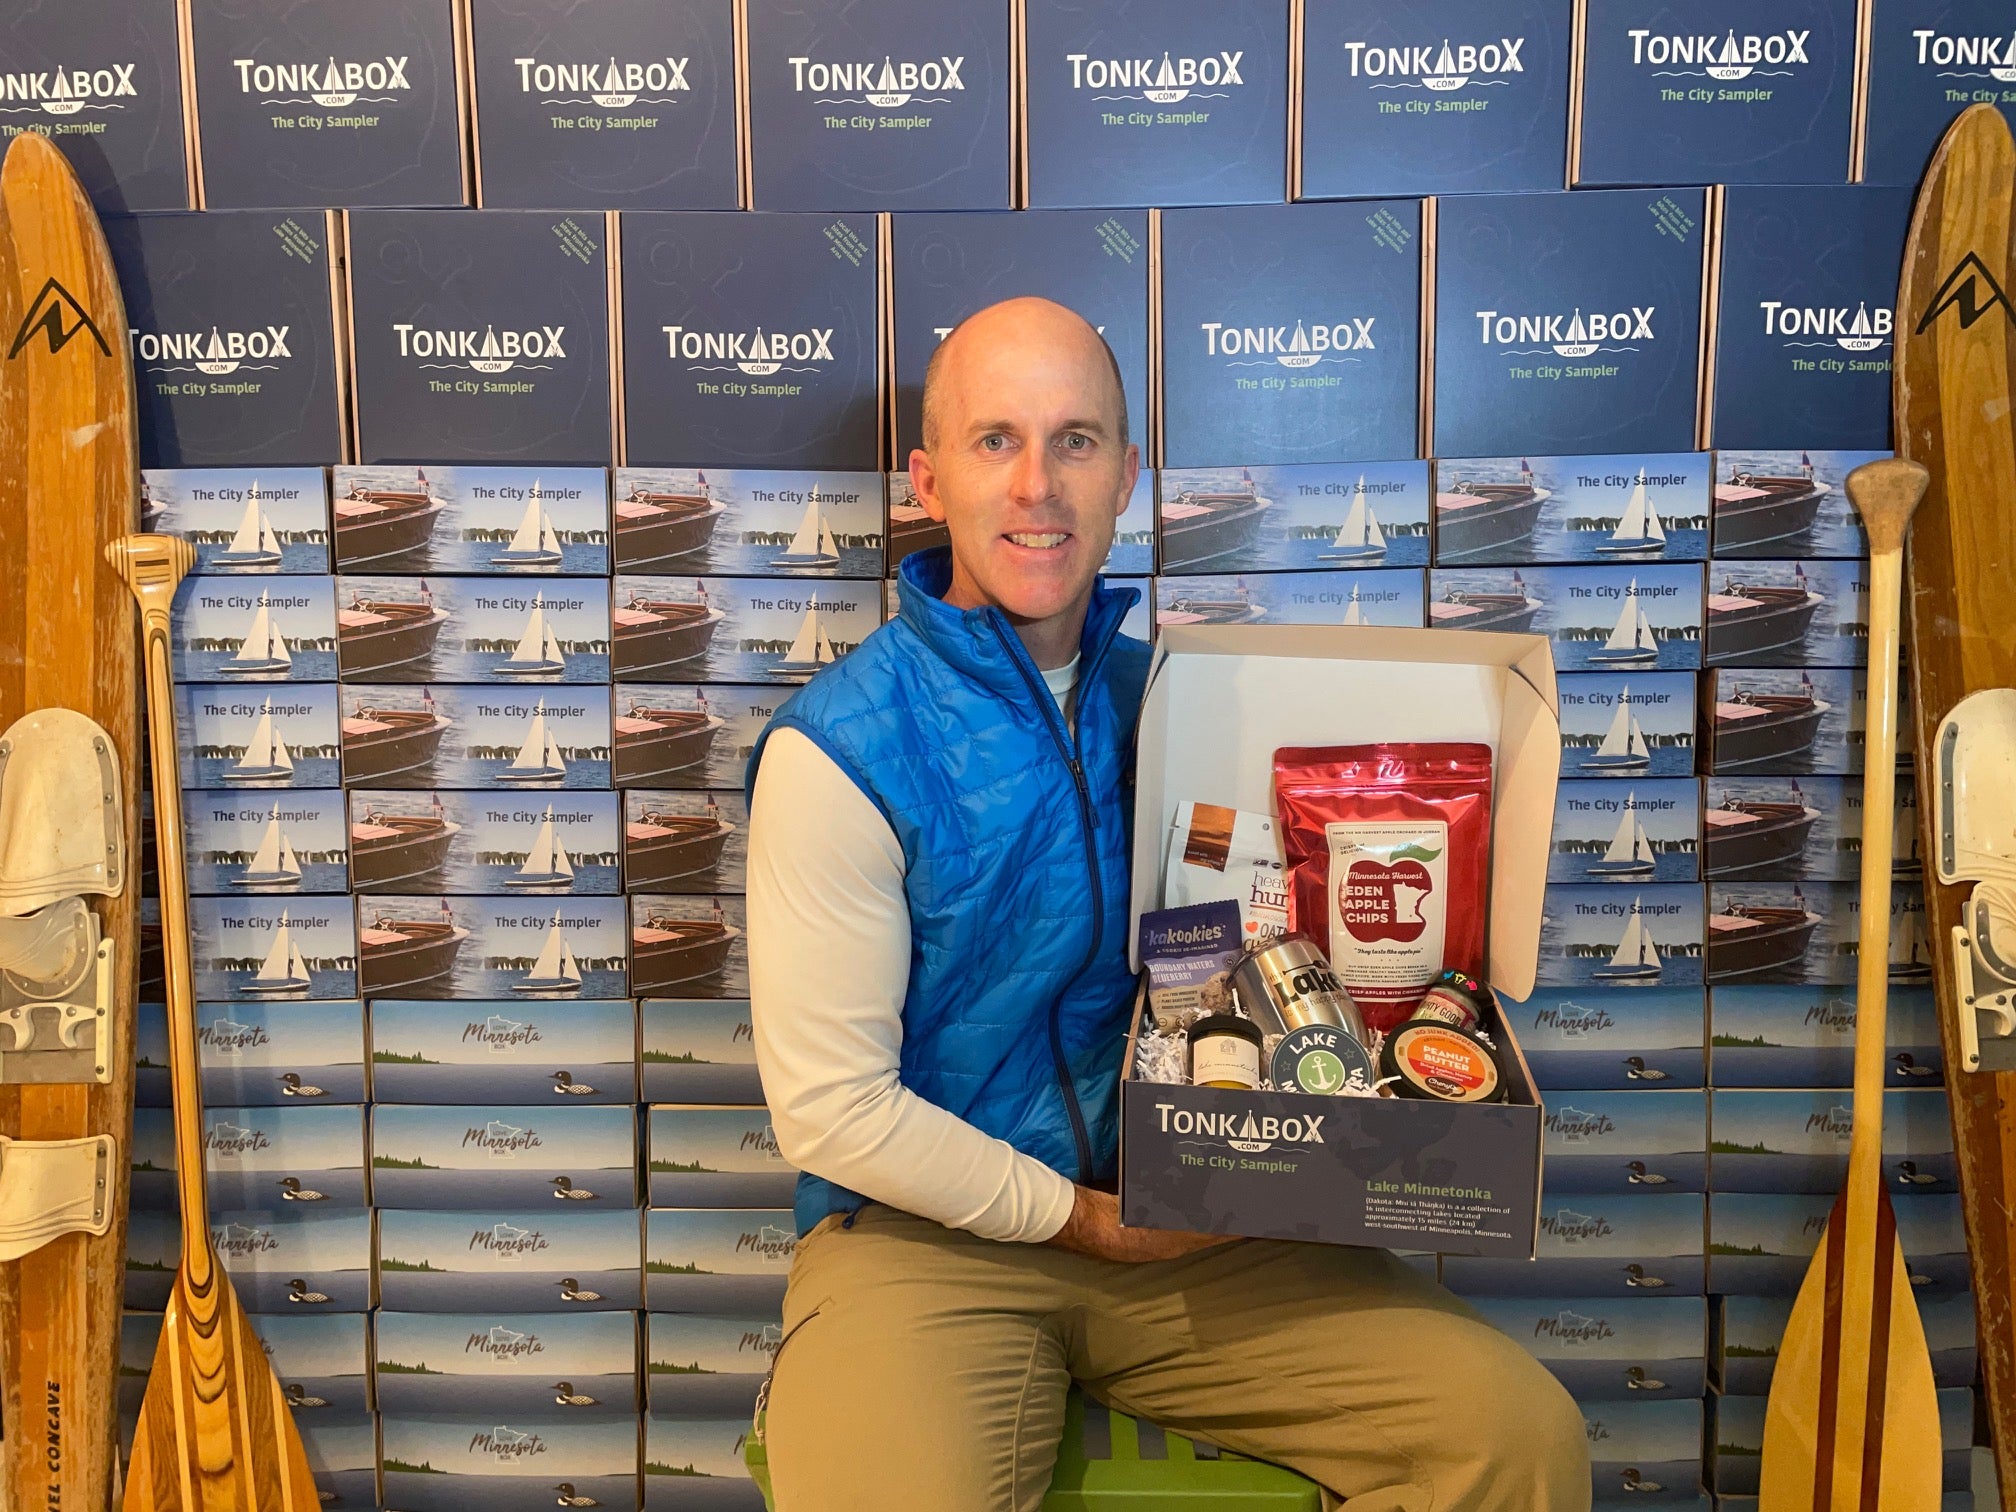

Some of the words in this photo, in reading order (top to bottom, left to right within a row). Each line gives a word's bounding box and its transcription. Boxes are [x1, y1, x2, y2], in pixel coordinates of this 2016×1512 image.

[1661, 88, 1684, 101] The
[1689, 88, 1714, 103] City
[1718, 87, 1773, 102] Sampler
[1378, 101, 1401, 113] The
[1406, 100, 1431, 115] City
[1435, 99, 1488, 113] Sampler
[271, 116, 294, 128] The
[298, 115, 323, 130] City
[327, 114, 379, 129] Sampler
[824, 116, 847, 128] The
[851, 116, 875, 131] City
[879, 115, 932, 130] Sampler
[1101, 113, 1124, 125] The
[1128, 112, 1153, 127] City
[1157, 111, 1210, 126] Sampler
[1509, 367, 1532, 379] The
[1537, 366, 1561, 380] City
[1566, 365, 1619, 379] Sampler
[1792, 359, 1815, 370] The
[1819, 358, 1844, 373] City
[157, 384, 178, 394] The
[183, 383, 206, 396] City
[210, 382, 261, 396] Sampler
[429, 380, 451, 392] The
[455, 380, 479, 395] City
[483, 381, 535, 395] Sampler
[697, 382, 719, 394] The
[723, 382, 747, 397] City
[751, 383, 802, 397] Sampler
[1236, 378, 1258, 389] The
[1262, 377, 1286, 391] City
[1290, 375, 1342, 389] Sampler
[1577, 476, 1600, 487] The
[1605, 475, 1629, 489] City
[1634, 474, 1687, 488] Sampler
[192, 489, 214, 500] The
[219, 489, 243, 502] City
[247, 488, 299, 501] Sampler
[1298, 485, 1320, 495] The
[1325, 484, 1349, 497] City
[1354, 482, 1405, 496] Sampler
[752, 490, 774, 501] The
[779, 490, 803, 504] City
[808, 490, 860, 505] Sampler
[475, 599, 498, 609] The
[503, 599, 527, 612] City
[531, 600, 583, 613] Sampler
[1561, 693, 1584, 704] The
[1589, 693, 1613, 706] City
[1618, 692, 1670, 706] Sampler
[213, 811, 236, 822] The
[240, 810, 263, 824] City
[268, 810, 319, 824] Sampler
[1349, 872, 1390, 880] Minnesota
[1391, 872, 1423, 880] Harvest
[1345, 886, 1383, 896] EDEN
[1345, 900, 1389, 910] APPLE
[495, 916, 517, 927] The
[522, 916, 545, 930] City
[550, 917, 601, 931] Sampler
[1346, 913, 1389, 923] CHIPS
[1148, 925, 1222, 946] kakookies
[1149, 963, 1186, 973] BOUNDARY
[1186, 960, 1215, 970] WATERS
[1152, 972, 1192, 983] BLUEBERRY
[1535, 1009, 1615, 1031] Minnesota
[462, 1023, 542, 1045] Minnesota
[1289, 1033, 1337, 1054] LAKE
[1423, 1045, 1470, 1063] PEANUT
[1424, 1054, 1470, 1071] BUTTER
[462, 1128, 542, 1150] Minnesota
[1180, 1154, 1204, 1166] The
[1209, 1156, 1235, 1171] City
[1240, 1159, 1298, 1174] Sampler
[1366, 1180, 1399, 1193] Lake
[1404, 1182, 1491, 1200] Minnetonka
[1376, 1207, 1431, 1217] interconnecting
[1433, 1210, 1451, 1218] lakes
[1467, 1205, 1501, 1214] collection
[1365, 1214, 1415, 1223] approximately
[1462, 1220, 1476, 1228] km)
[469, 1230, 550, 1252] Minnesota
[1535, 1317, 1615, 1339] Minnesota
[466, 1333, 545, 1355] Minnesota
[47, 1381, 60, 1473] CONCAVE
[470, 1433, 549, 1456] Minnesota
